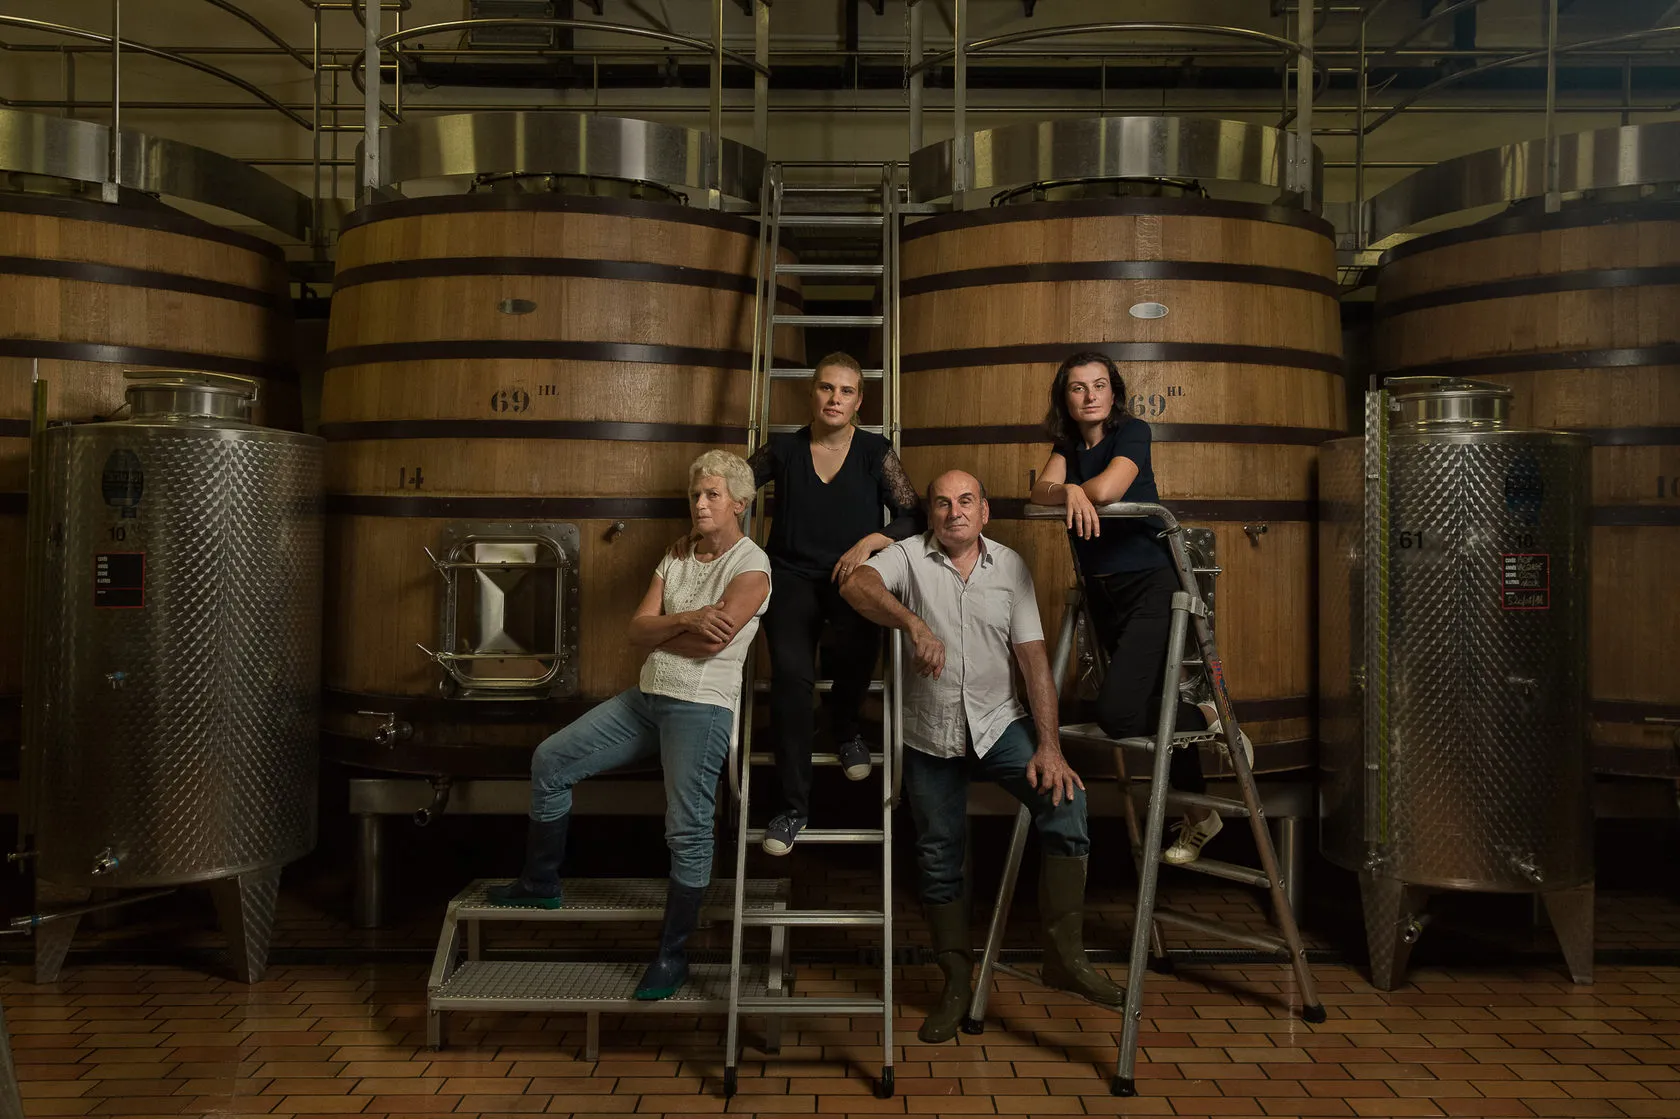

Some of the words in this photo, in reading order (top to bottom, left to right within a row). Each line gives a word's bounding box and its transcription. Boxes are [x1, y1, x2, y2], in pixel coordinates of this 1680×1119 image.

[491, 389, 530, 413] 69
[1127, 393, 1167, 417] 69
[1167, 386, 1186, 397] HL
[399, 466, 424, 489] 14
[108, 526, 126, 542] 10
[1399, 531, 1423, 549] 61
[1515, 534, 1533, 548] 10
